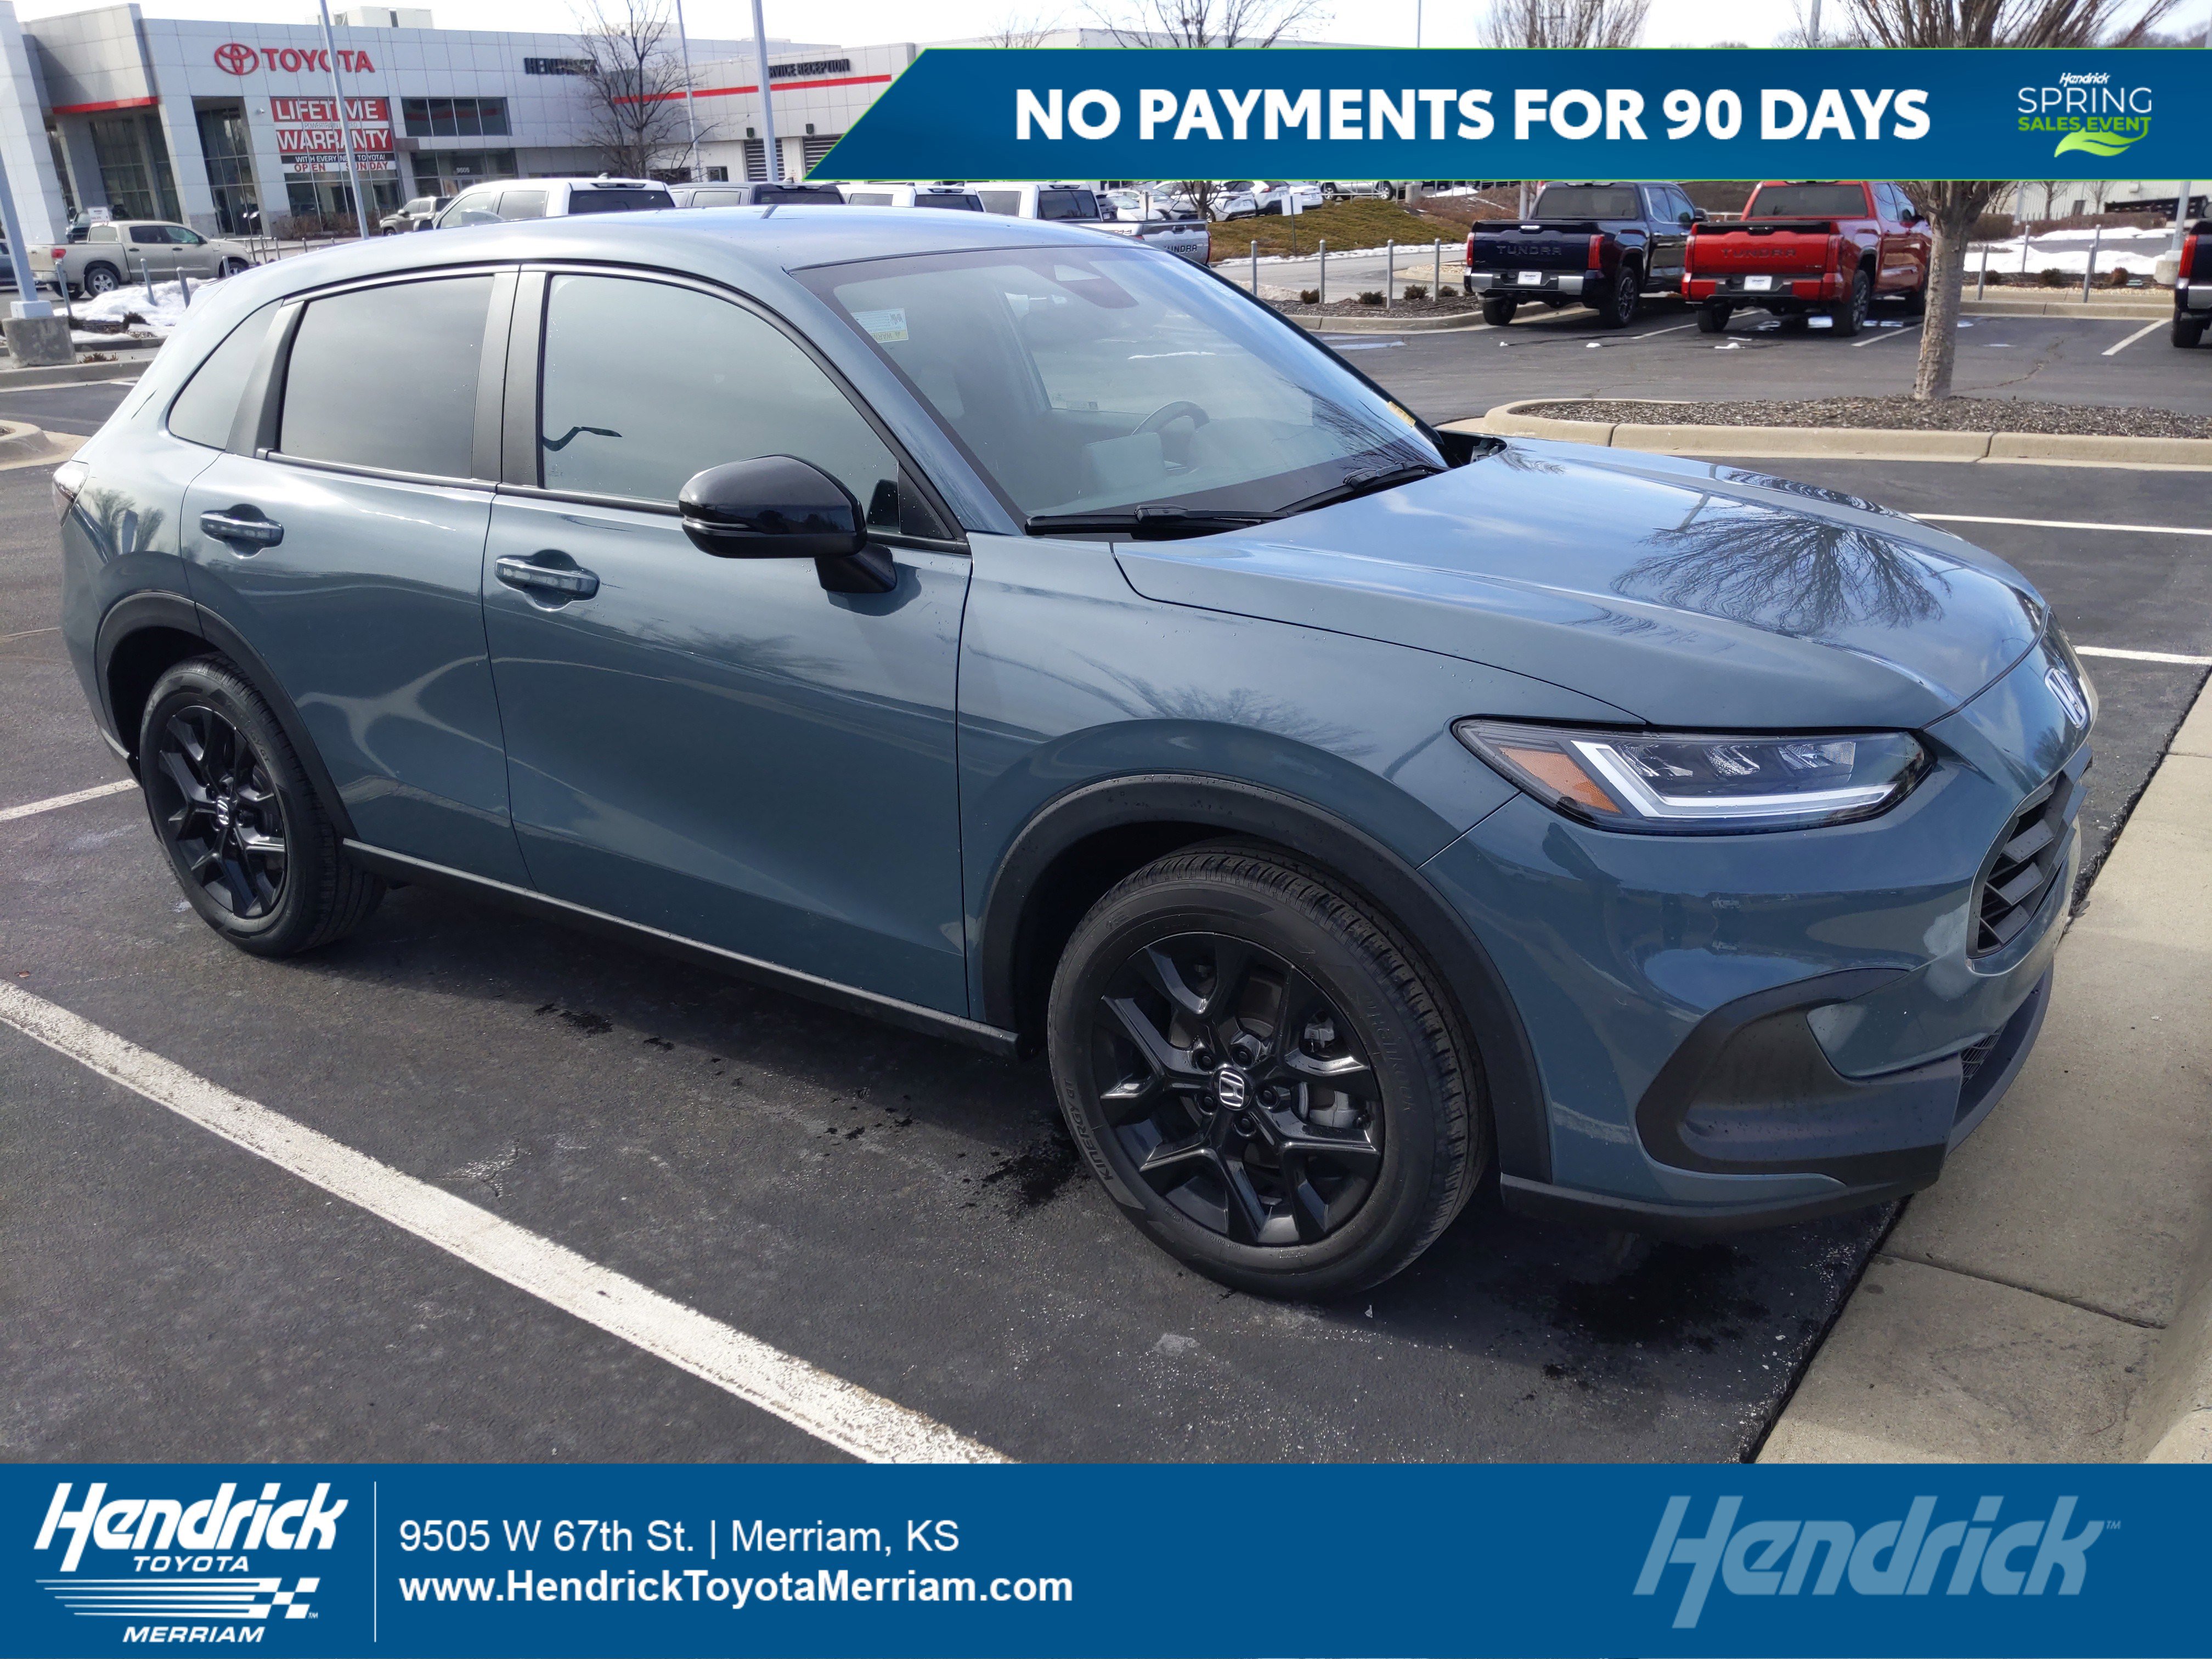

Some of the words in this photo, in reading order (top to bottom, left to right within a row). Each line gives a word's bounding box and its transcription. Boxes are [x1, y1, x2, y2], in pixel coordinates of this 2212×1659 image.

[261, 48, 375, 73] TOYOTA
[768, 63, 796, 78] RVICE
[275, 100, 379, 120] LIFETIME
[294, 163, 326, 172] OPEN
[1164, 245, 1197, 253] UNDRA
[1497, 245, 1562, 255] TUNDRA
[1722, 249, 1796, 258] TUNDRA
[1067, 1100, 1114, 1180] KINERGY
